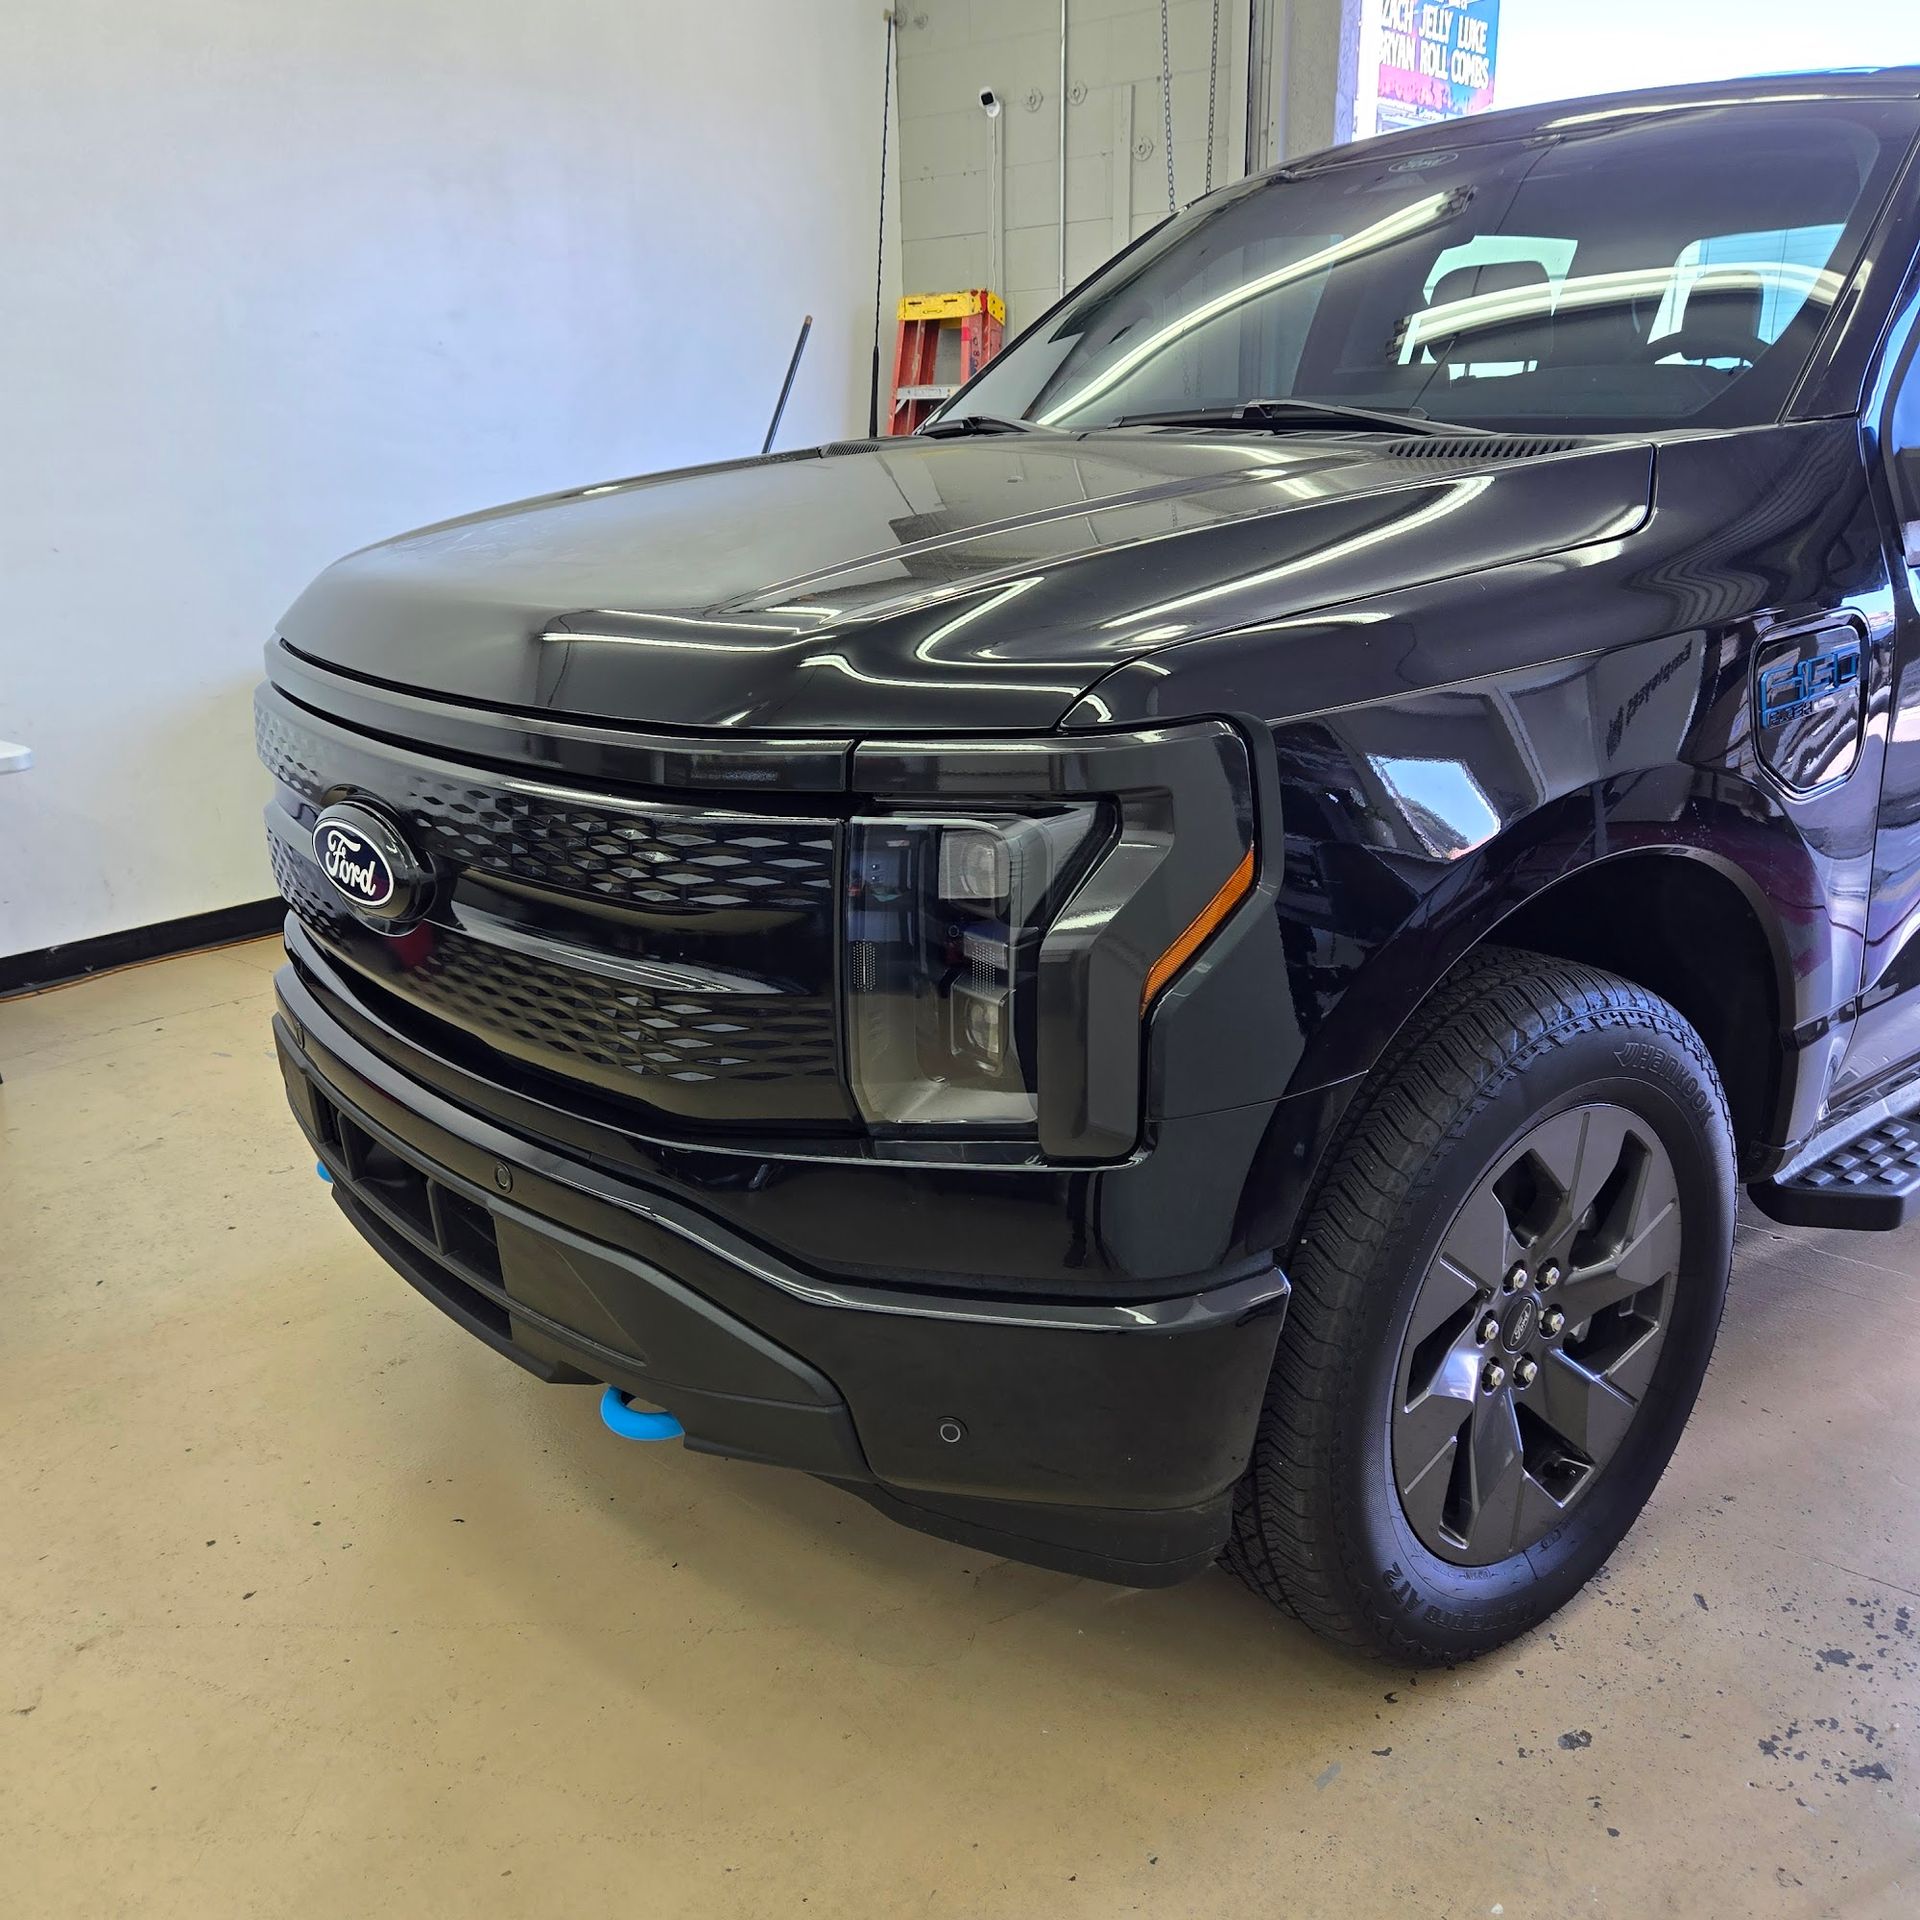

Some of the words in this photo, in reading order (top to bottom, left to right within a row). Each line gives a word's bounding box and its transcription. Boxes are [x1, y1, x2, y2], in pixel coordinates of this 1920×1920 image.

[1419, 4, 1453, 43] JELLY
[1458, 16, 1488, 53] LUKE
[1420, 41, 1448, 80] ROLL
[1451, 49, 1490, 89] COMBS
[325, 830, 376, 896] Ford
